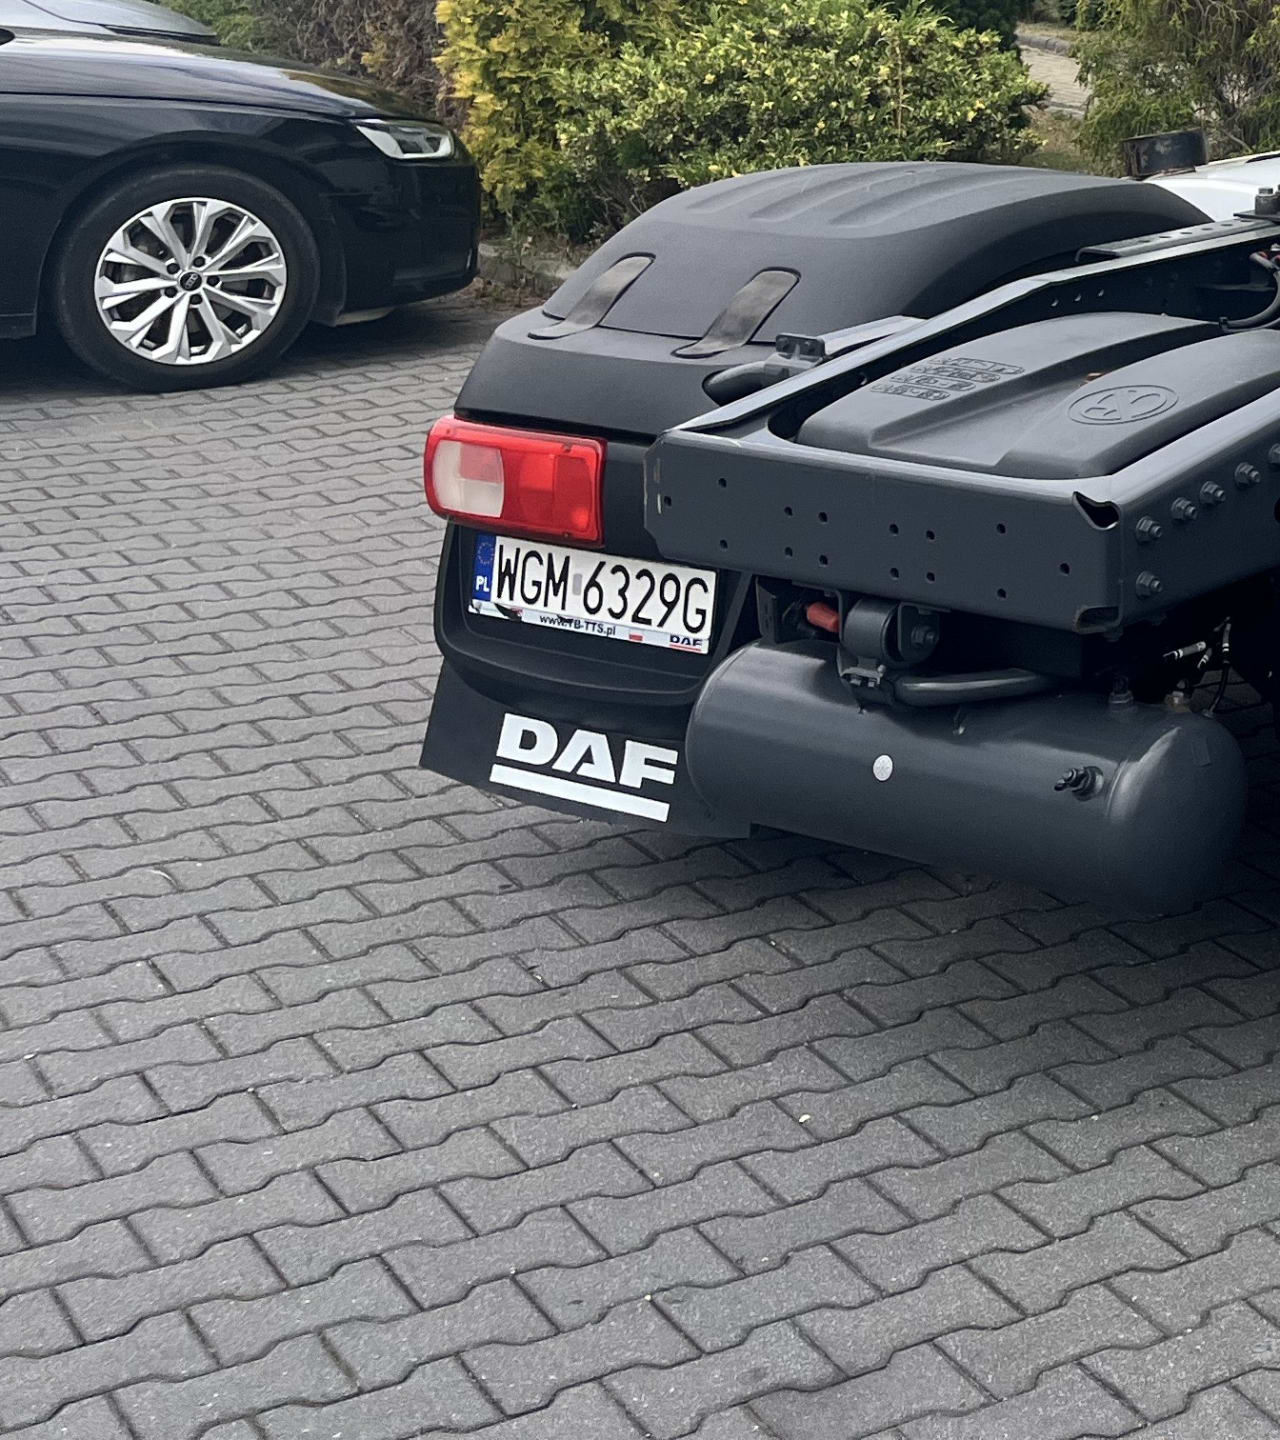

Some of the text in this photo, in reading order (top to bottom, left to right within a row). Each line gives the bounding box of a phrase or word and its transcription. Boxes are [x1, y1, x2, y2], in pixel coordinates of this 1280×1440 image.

[475, 575, 490, 593] PL
[497, 544, 709, 634] WGM 6329G
[669, 635, 704, 647] DAF
[496, 713, 679, 789] DAF
